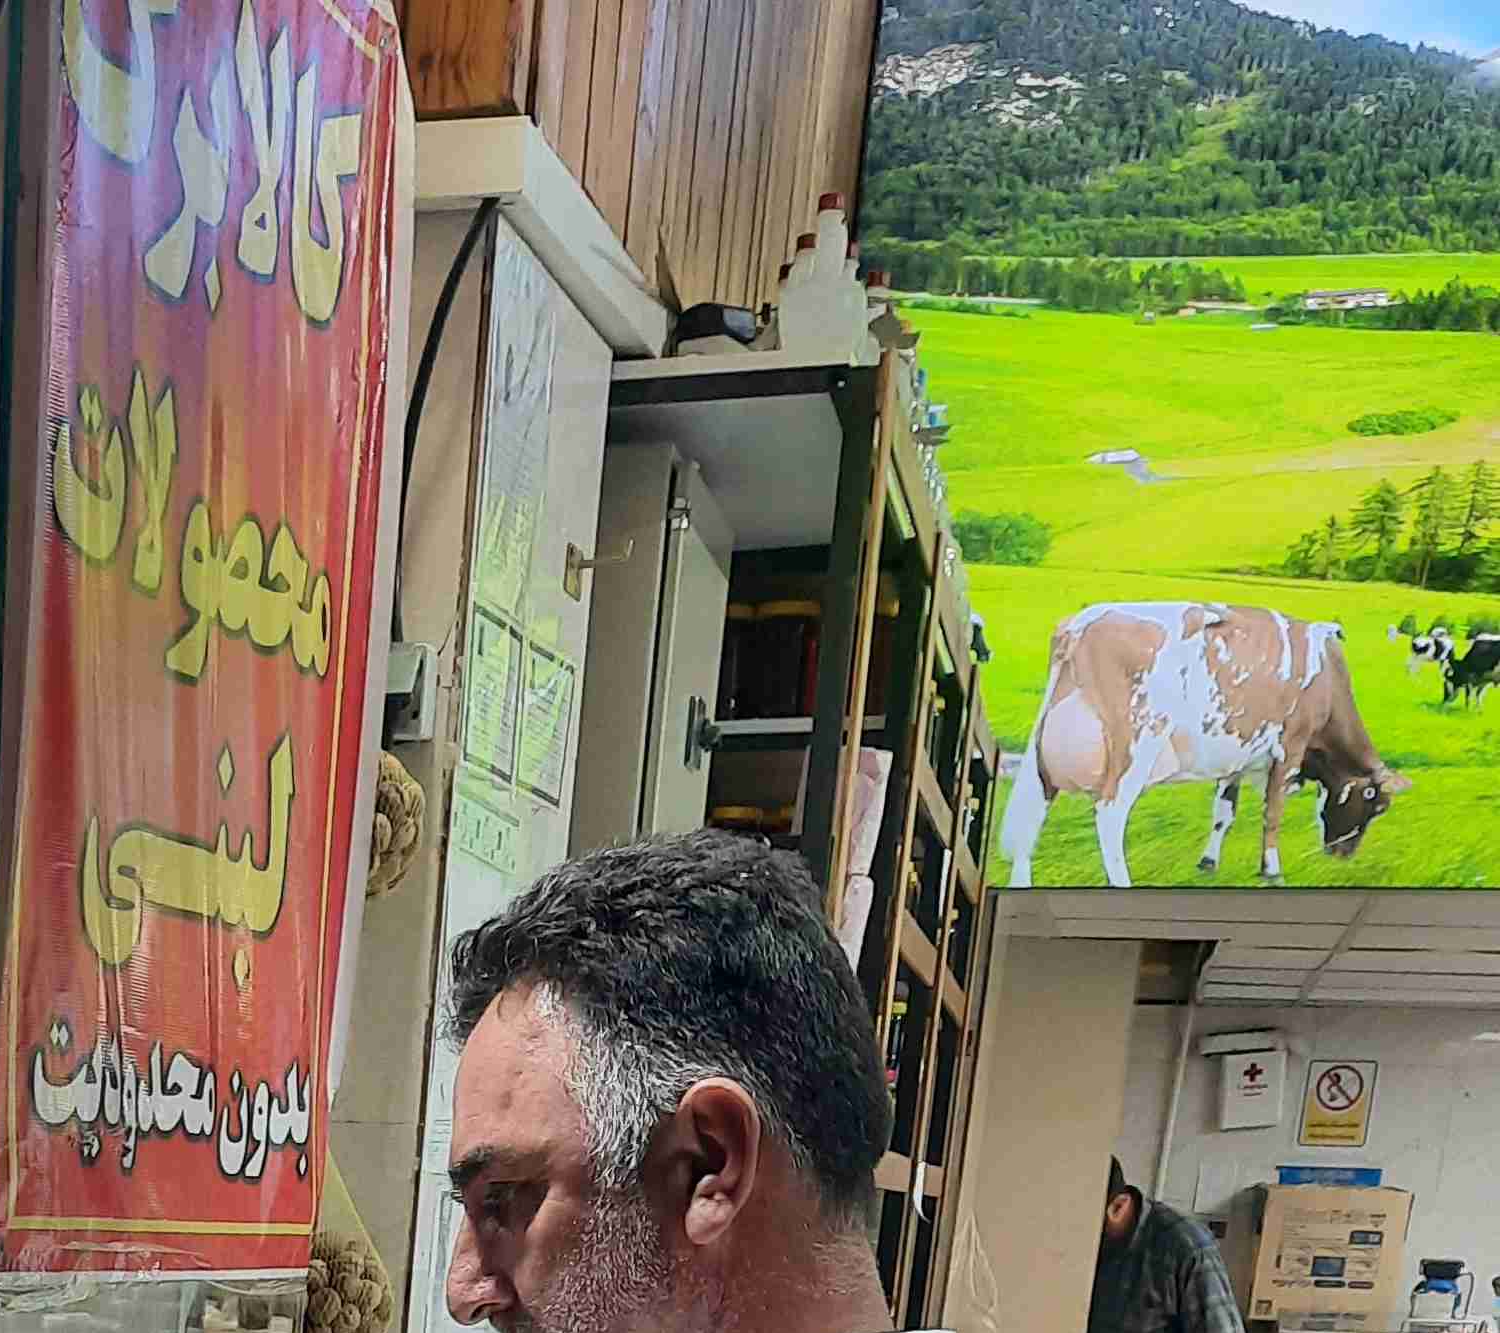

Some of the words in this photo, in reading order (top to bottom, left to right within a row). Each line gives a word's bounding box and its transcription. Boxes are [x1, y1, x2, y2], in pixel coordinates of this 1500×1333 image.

[53, 366, 332, 682] محصولات
[81, 730, 295, 989] لبنی
[33, 1022, 216, 1170] محدودیت
[218, 1061, 311, 1178] بدون
